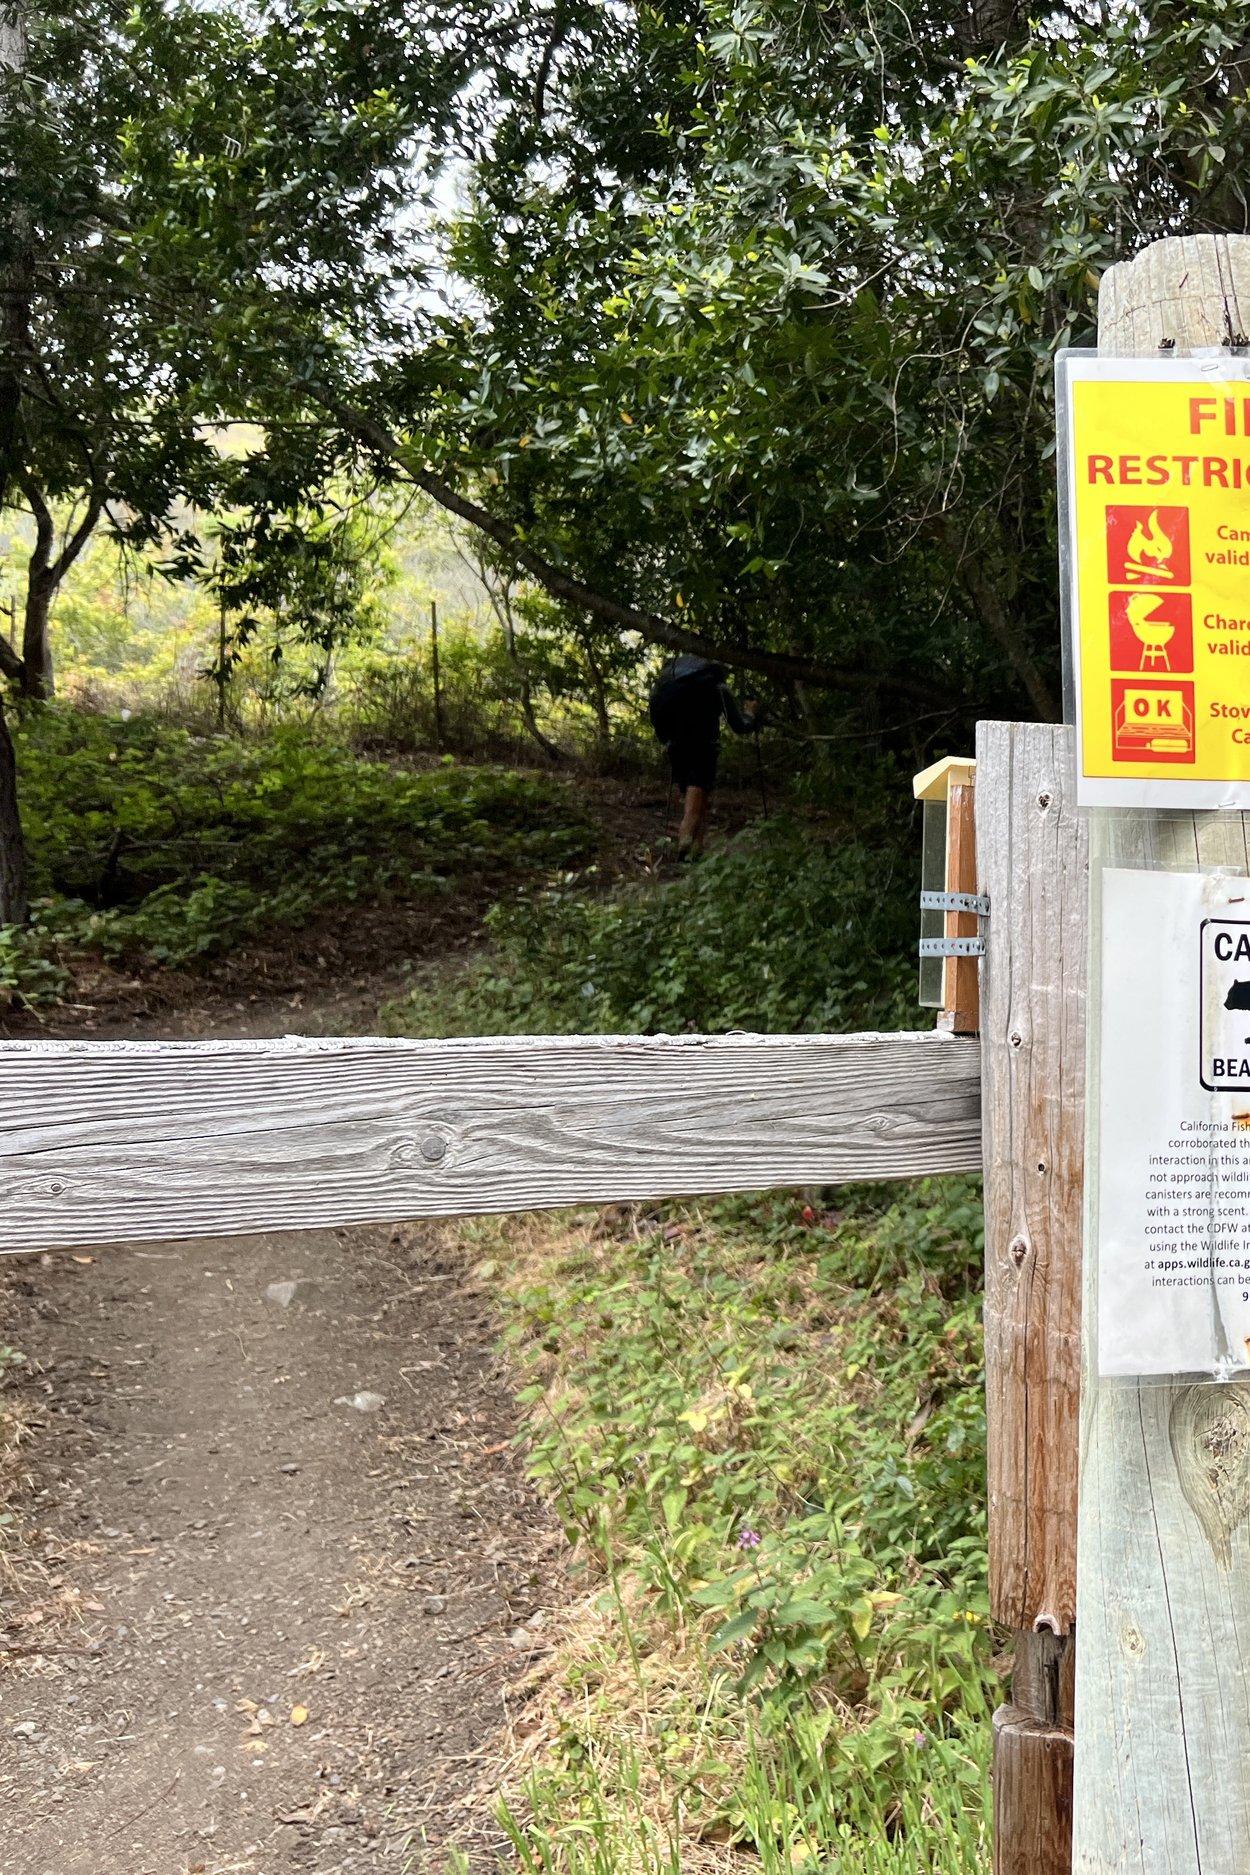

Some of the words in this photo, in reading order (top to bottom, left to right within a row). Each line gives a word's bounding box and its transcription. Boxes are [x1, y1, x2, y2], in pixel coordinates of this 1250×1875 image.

[1206, 549, 1250, 567] valid
[1180, 1121, 1228, 1131] California
[1232, 1122, 1250, 1132] Fish
[1168, 1138, 1236, 1148] corroborated
[1149, 1155, 1205, 1165] interaction
[1208, 1155, 1218, 1165] in
[1221, 1155, 1239, 1165] this
[1150, 1173, 1167, 1182] not
[1171, 1173, 1218, 1184] approach
[1146, 1190, 1192, 1199] canisters
[1147, 1207, 1169, 1216] with
[1182, 1207, 1214, 1218] strong
[1218, 1206, 1248, 1216] scent.
[1145, 1225, 1183, 1234] contact
[1188, 1224, 1204, 1233] the
[1207, 1223, 1238, 1233] CDFW
[1150, 1242, 1177, 1253] using
[1181, 1241, 1197, 1251] the
[1201, 1240, 1239, 1250] Wildlife
[1145, 1260, 1155, 1269] at
[1152, 1276, 1214, 1287] interactions
[1217, 1277, 1234, 1285] can
[1238, 1275, 1250, 1284] be
